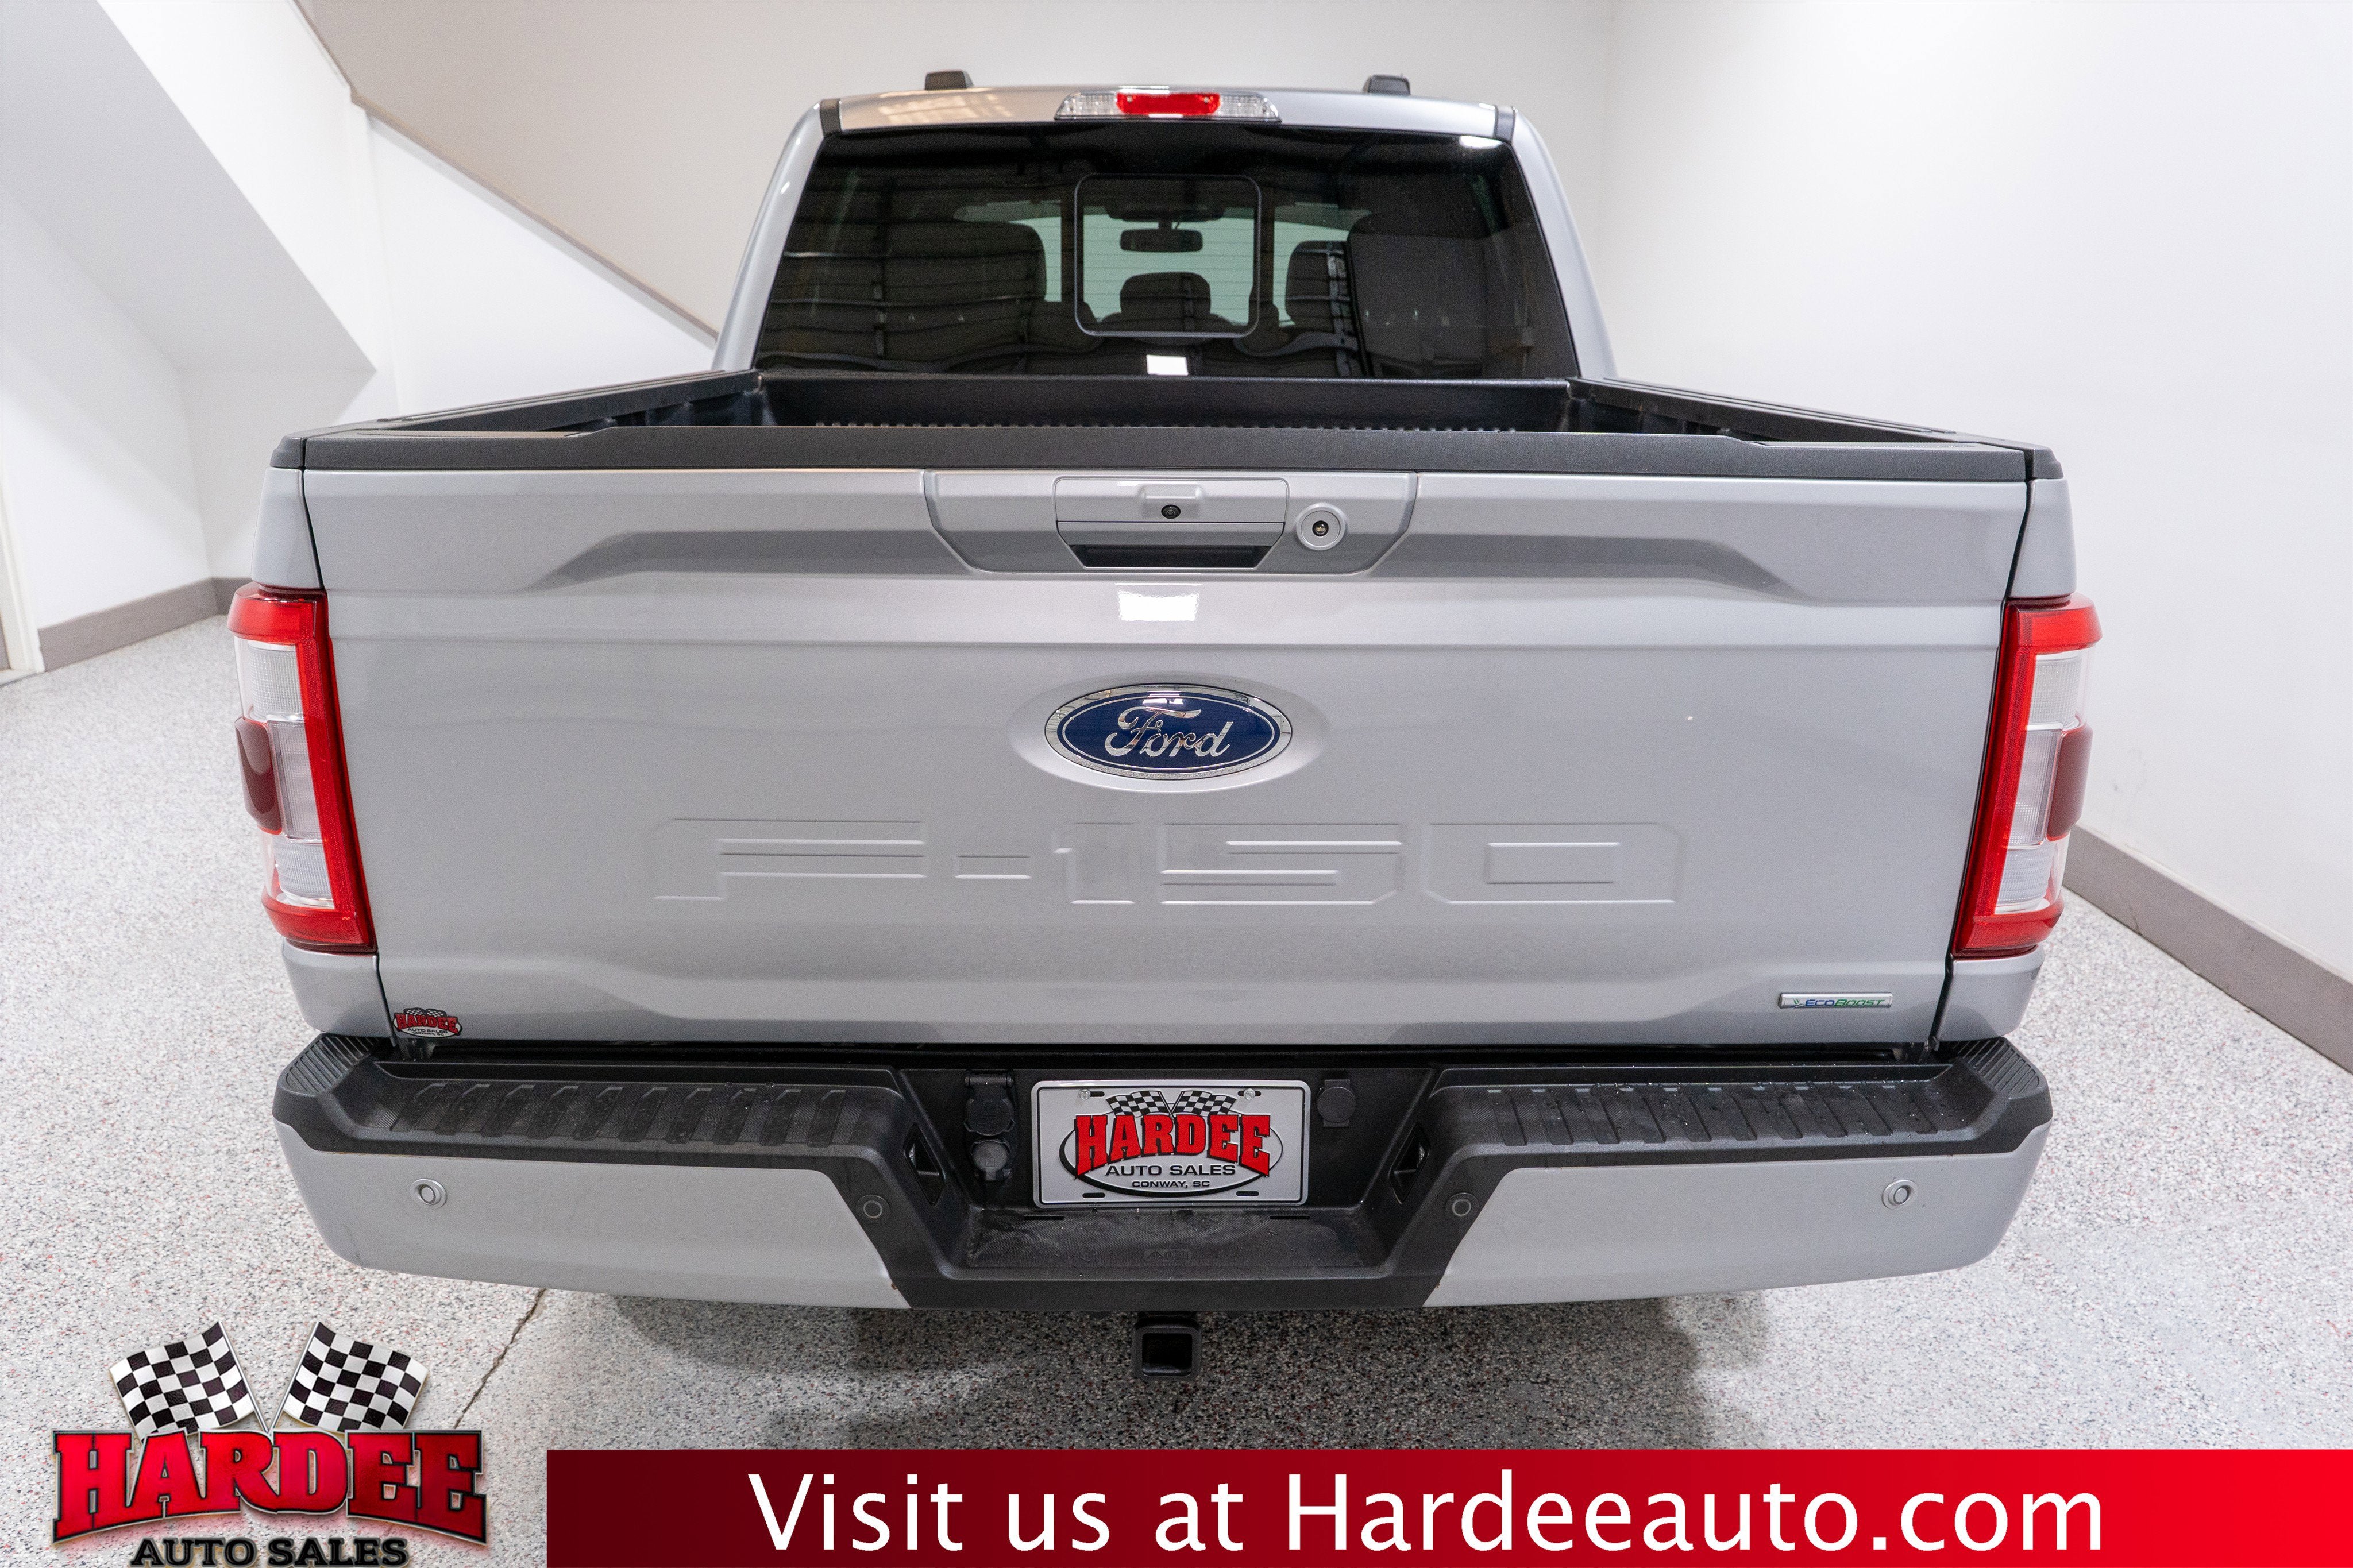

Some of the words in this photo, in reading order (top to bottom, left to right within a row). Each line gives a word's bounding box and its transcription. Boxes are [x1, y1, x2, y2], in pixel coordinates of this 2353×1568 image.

[1104, 706, 1234, 758] Ford
[648, 819, 1683, 905] F-150
[394, 1013, 460, 1035] HARDEE
[1074, 1114, 1271, 1177] HARDEE
[1105, 1165, 1163, 1176] AUTO
[1169, 1164, 1236, 1176] SALES
[1131, 1180, 1188, 1188] CONWAY,
